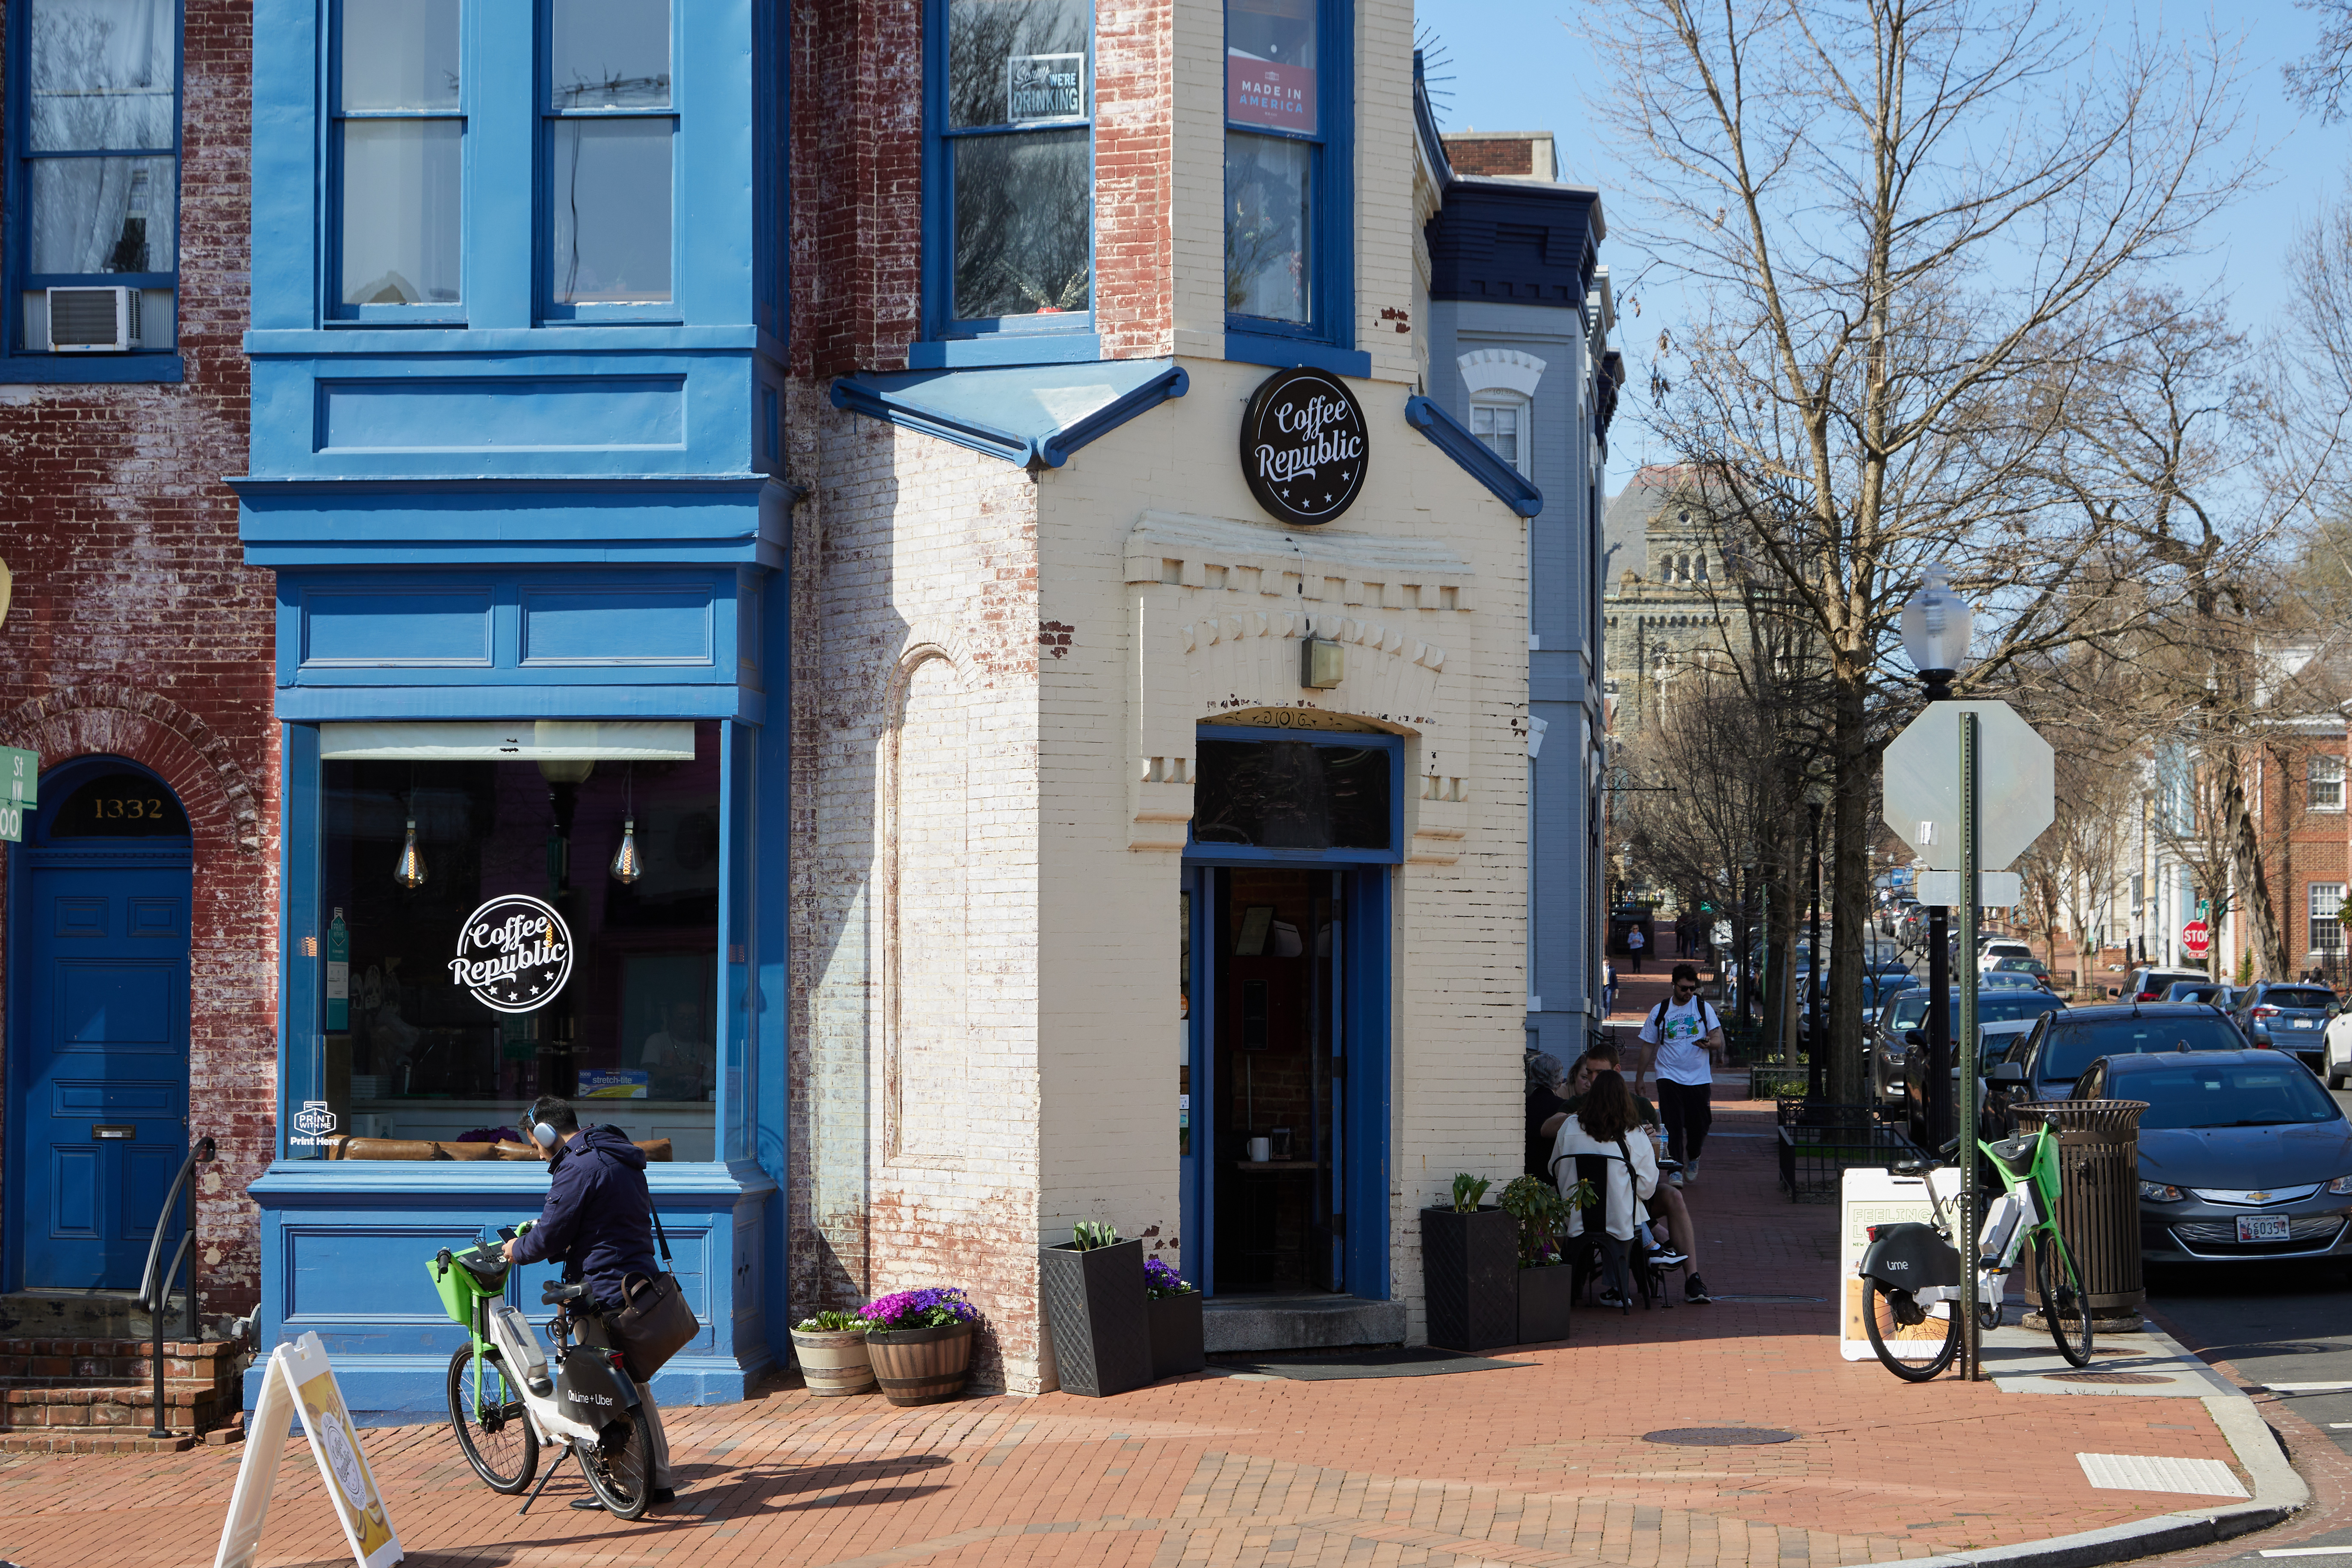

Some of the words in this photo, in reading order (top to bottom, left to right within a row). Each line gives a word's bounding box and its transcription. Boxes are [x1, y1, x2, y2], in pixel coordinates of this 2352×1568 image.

[1013, 65, 1049, 88] Sorry
[1049, 72, 1076, 87] WE'RE
[1014, 88, 1078, 112] DRINKING
[1242, 80, 1281, 97] MADE
[1288, 88, 1301, 100] IN
[1240, 94, 1303, 113] AMERICA
[1274, 394, 1348, 441] Coffee
[1255, 430, 1363, 482] Republic
[14, 756, 23, 777] St
[12, 780, 23, 801] NW
[95, 799, 163, 818] 1332
[468, 914, 550, 953] Coffee
[448, 940, 567, 987] Republic
[299, 1115, 331, 1123] PRINT
[290, 1137, 314, 1146] Print
[316, 1137, 339, 1146] Here
[1853, 1208, 1931, 1222] FEELING
[1886, 1260, 1909, 1271] Lime
[595, 1394, 613, 1406] Uber
[331, 1437, 343, 1461] Coffee
[336, 1450, 352, 1483] Republic
[351, 1484, 366, 1507] BREAKFAST
